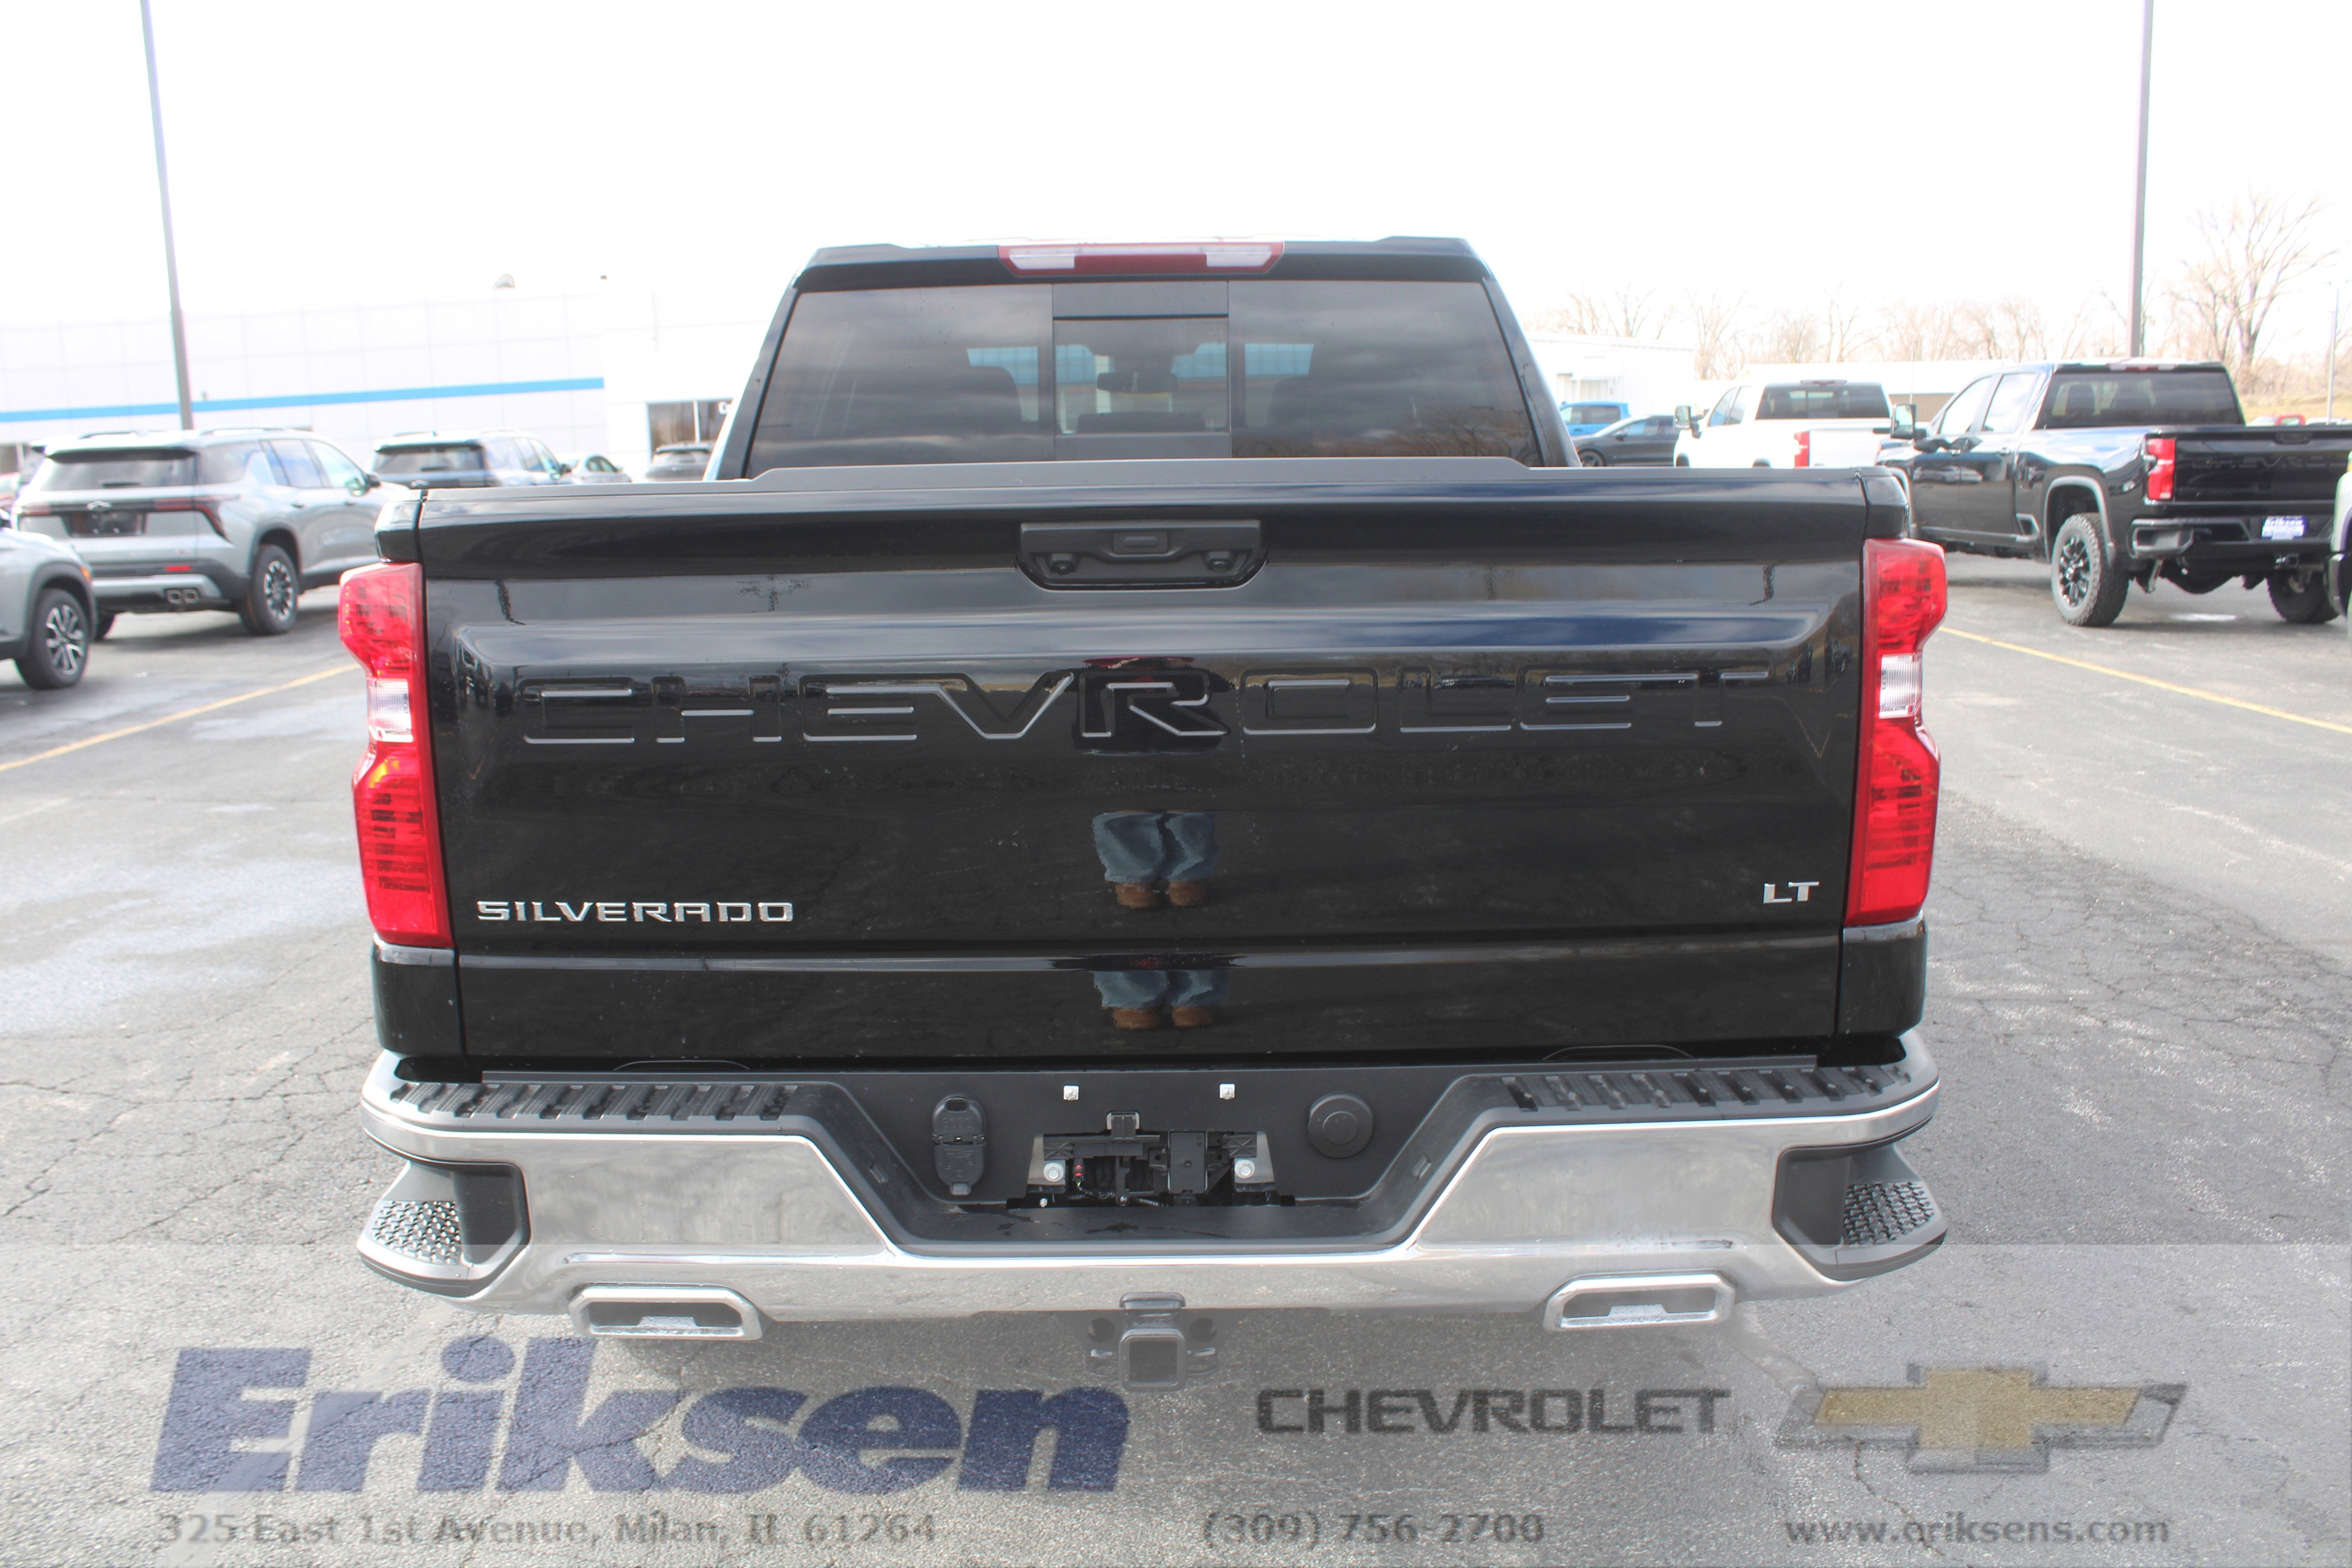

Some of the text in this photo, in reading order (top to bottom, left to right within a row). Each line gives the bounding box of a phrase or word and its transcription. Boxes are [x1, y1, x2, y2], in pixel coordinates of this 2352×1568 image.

[521, 661, 1775, 744] CHEVROLET
[1763, 881, 1820, 904] LT
[477, 901, 794, 922] SILVERADO
